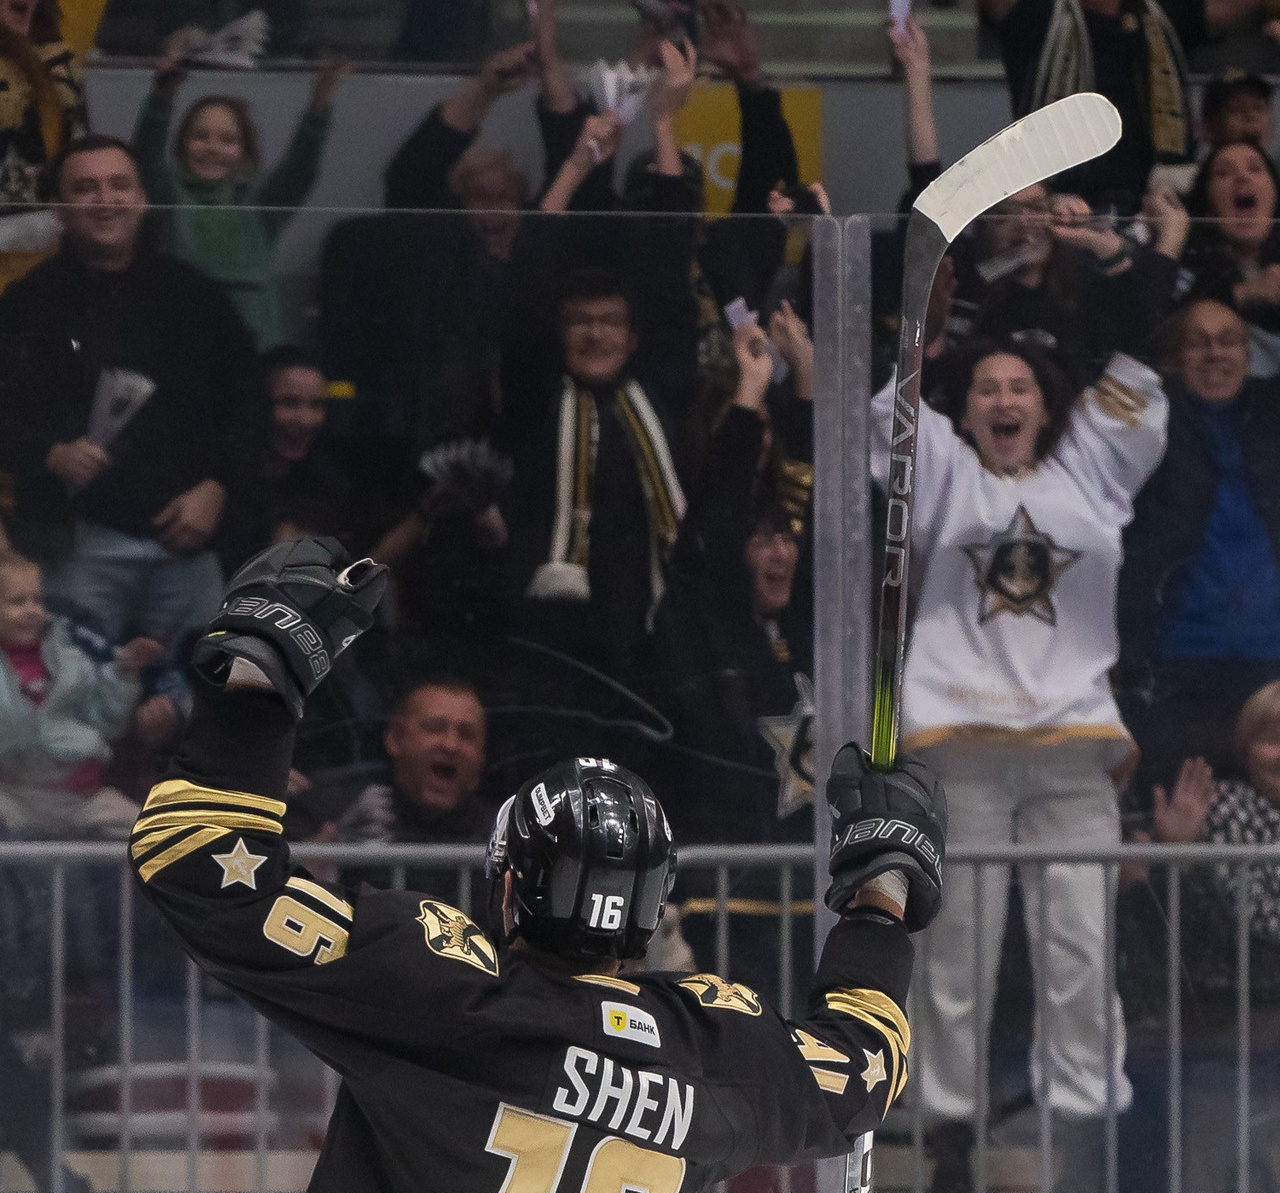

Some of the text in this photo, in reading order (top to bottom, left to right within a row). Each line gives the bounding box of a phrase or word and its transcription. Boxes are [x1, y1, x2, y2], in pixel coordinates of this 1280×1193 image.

[227, 596, 332, 680] BAUE
[589, 893, 624, 930] 16
[629, 1018, 656, 1035] БАНК
[552, 1045, 695, 1151] SHEN
